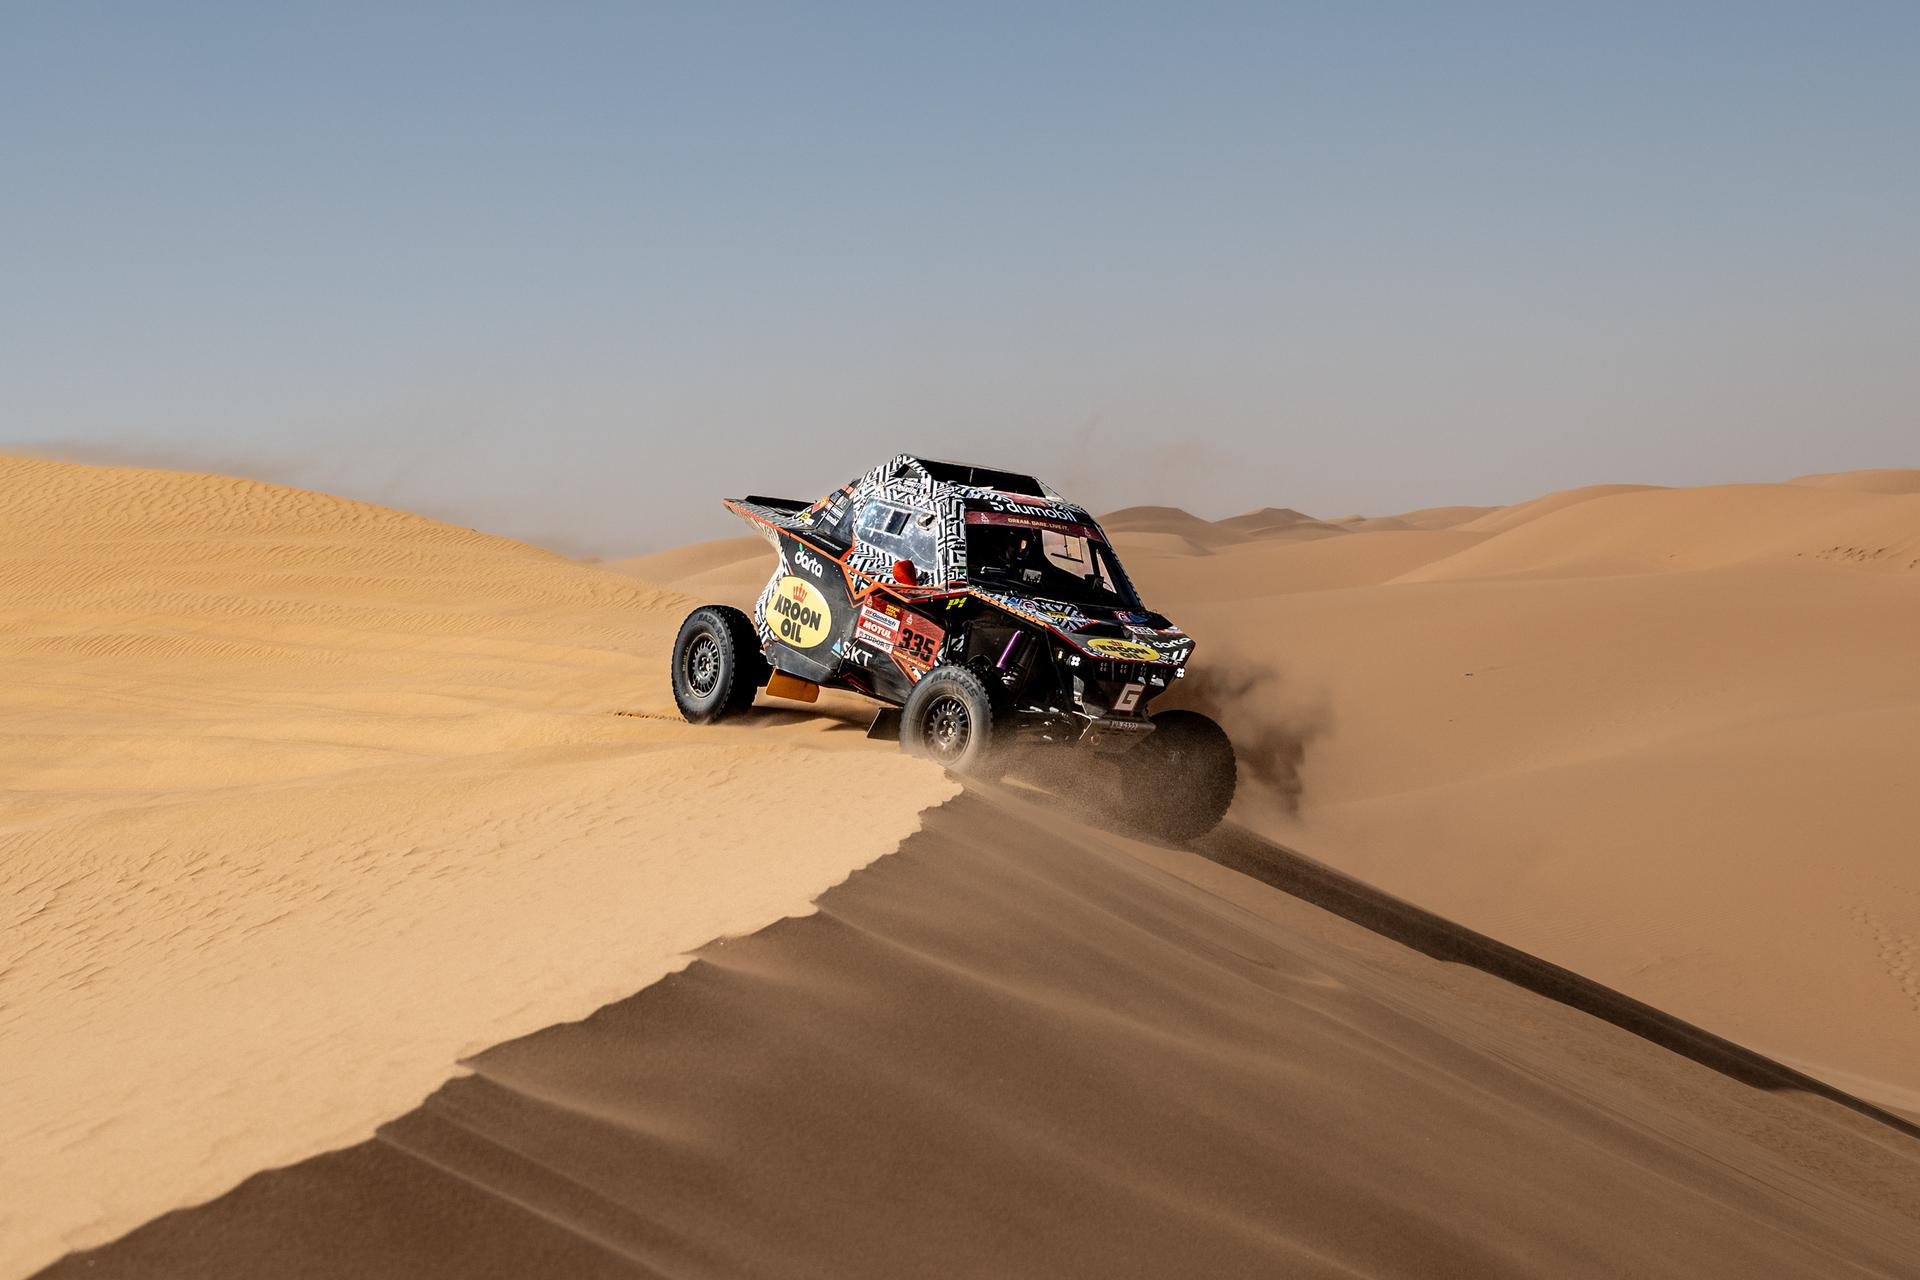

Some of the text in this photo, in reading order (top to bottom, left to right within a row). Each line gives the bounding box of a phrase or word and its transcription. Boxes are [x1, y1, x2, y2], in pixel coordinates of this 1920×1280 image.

[794, 550, 823, 578] darta
[774, 594, 821, 631] KROON
[865, 608, 896, 627] BFGoodrich
[780, 618, 801, 643] OIL
[863, 620, 891, 639] MOTUL
[841, 641, 873, 667] SKT
[899, 627, 935, 662] 335
